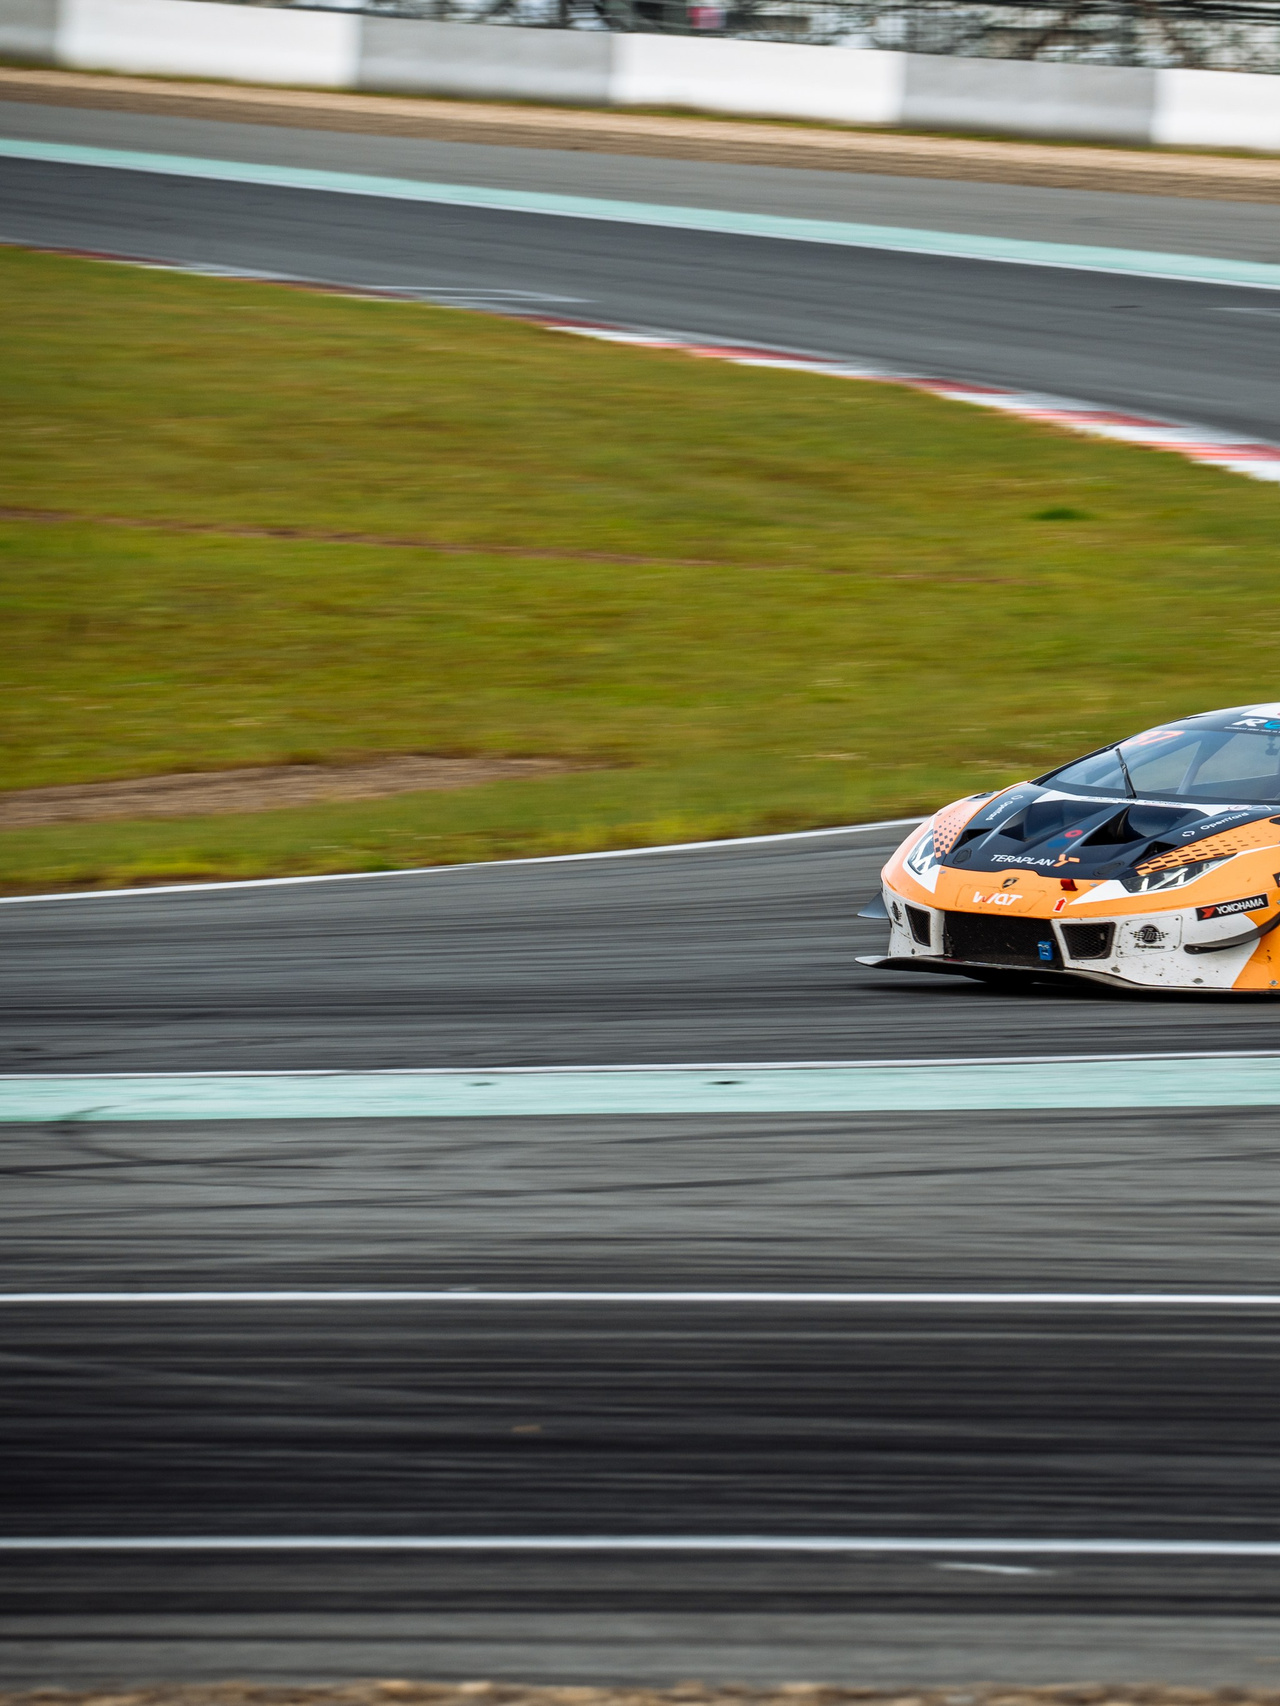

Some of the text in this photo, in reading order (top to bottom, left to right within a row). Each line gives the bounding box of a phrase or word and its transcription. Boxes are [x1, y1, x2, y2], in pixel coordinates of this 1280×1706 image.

[1200, 812, 1250, 830] OpenYard
[990, 854, 1056, 867] TERAPLAN
[1216, 898, 1265, 915] YOKOHAMA
